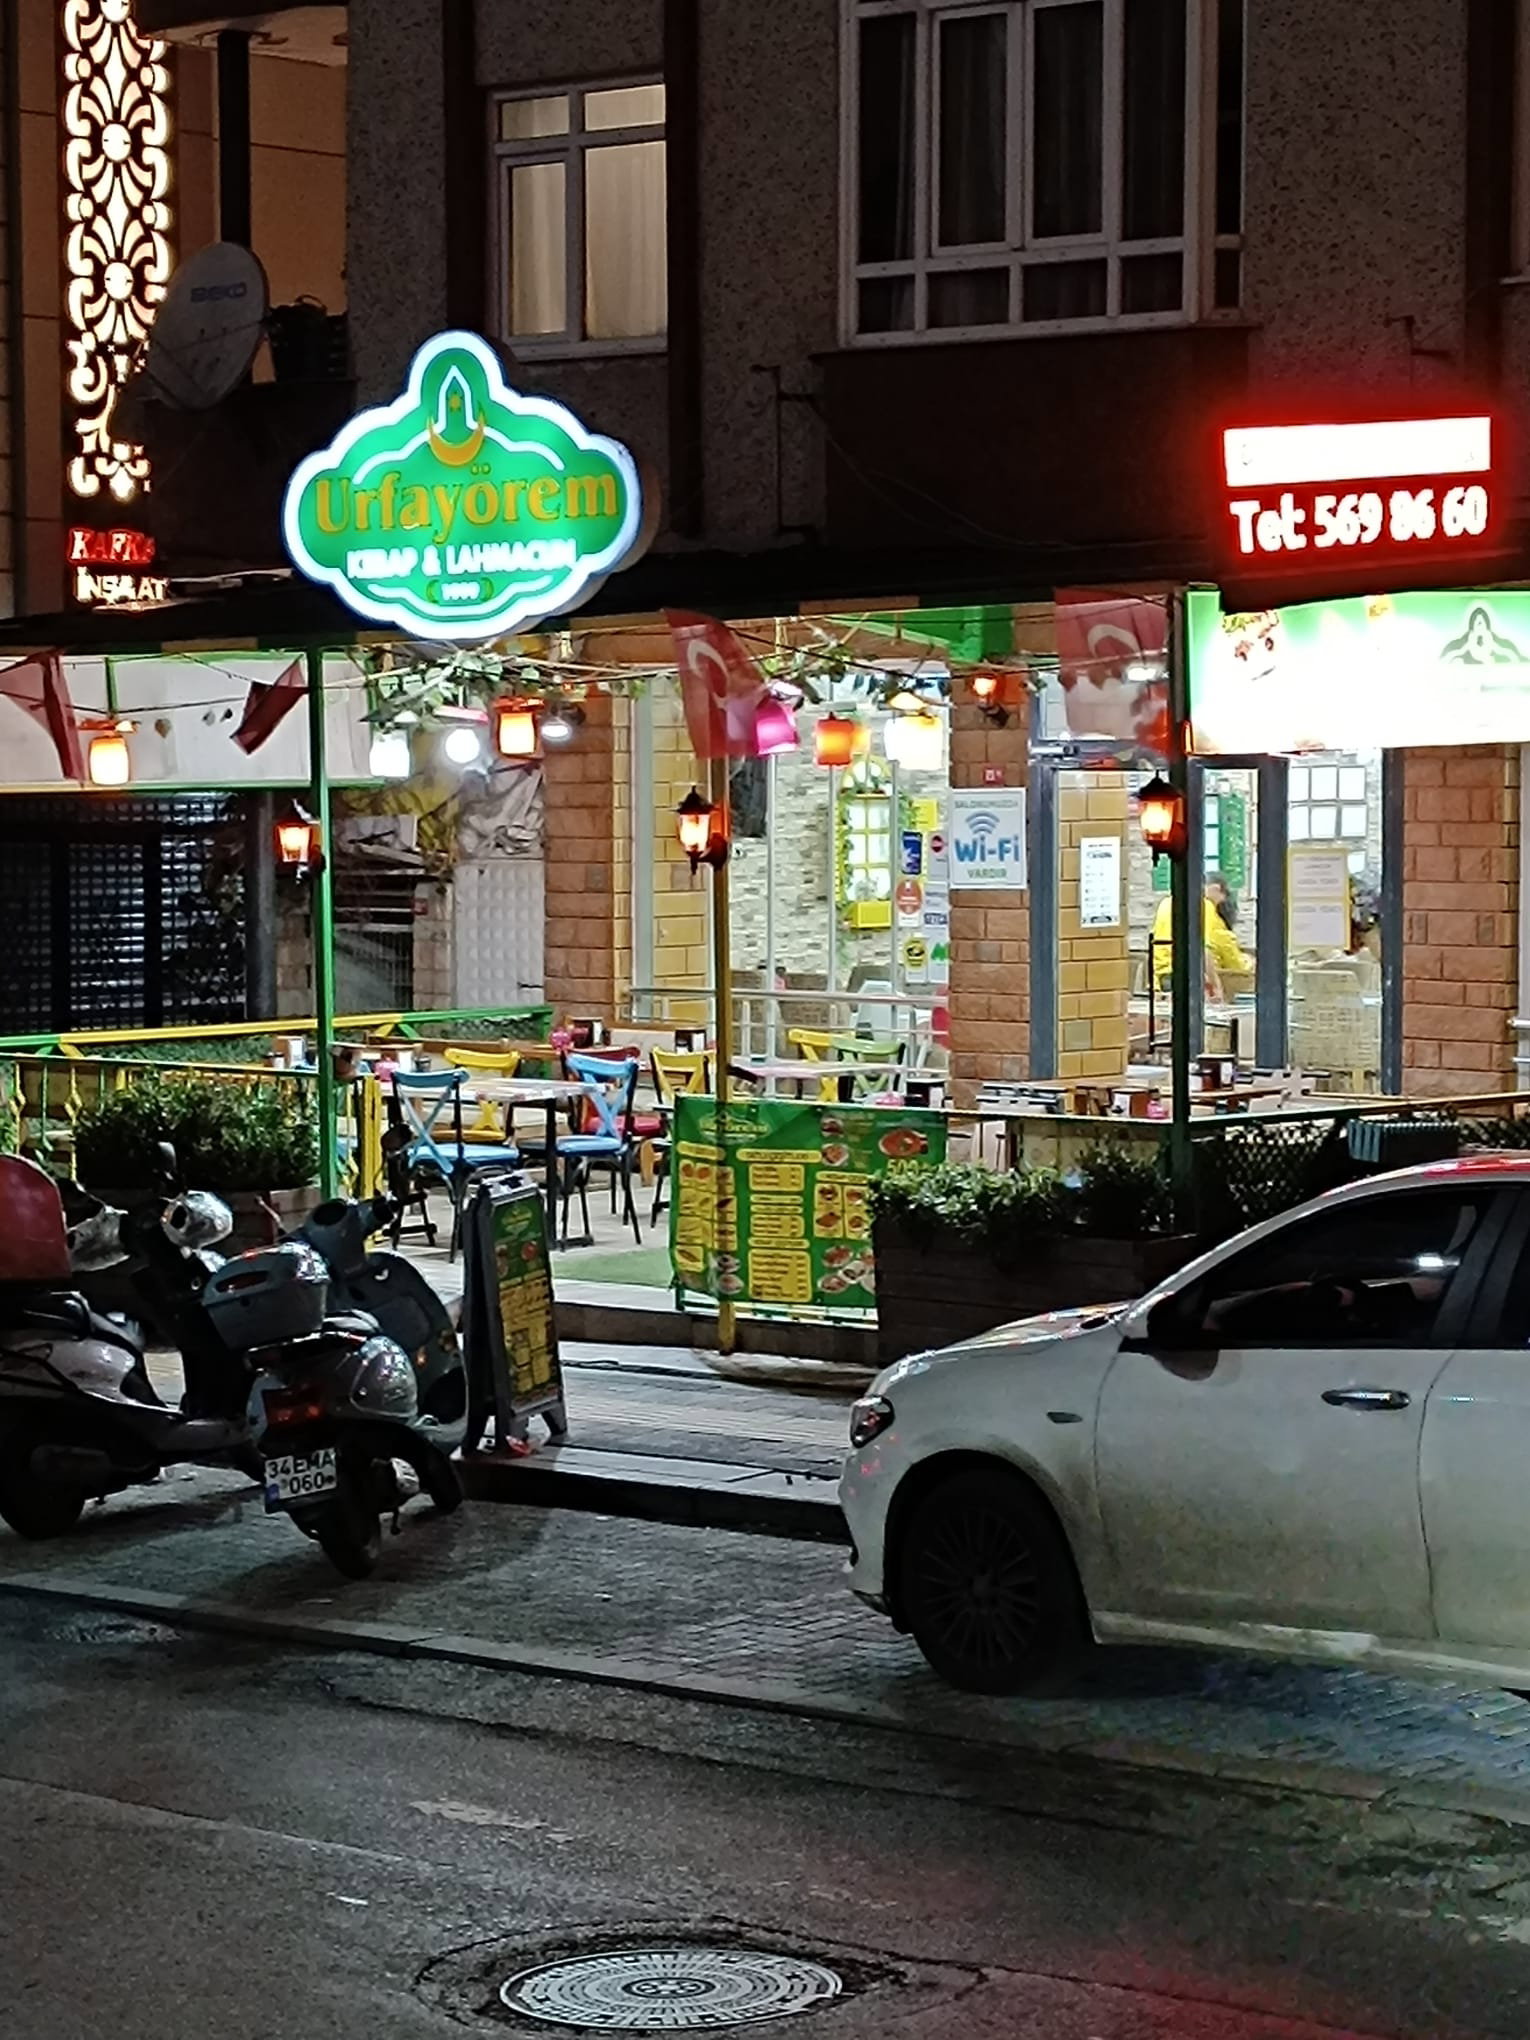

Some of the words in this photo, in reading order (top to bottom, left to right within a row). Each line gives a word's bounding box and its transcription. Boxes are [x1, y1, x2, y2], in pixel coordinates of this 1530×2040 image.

[315, 463, 617, 544] Urfayörem
[1314, 492, 1383, 548] 569
[1389, 488, 1436, 541] 86
[1442, 485, 1487, 536] 60
[421, 545, 441, 576] &
[954, 834, 1019, 862] Wi-Fi
[289, 1471, 325, 1494] 060
